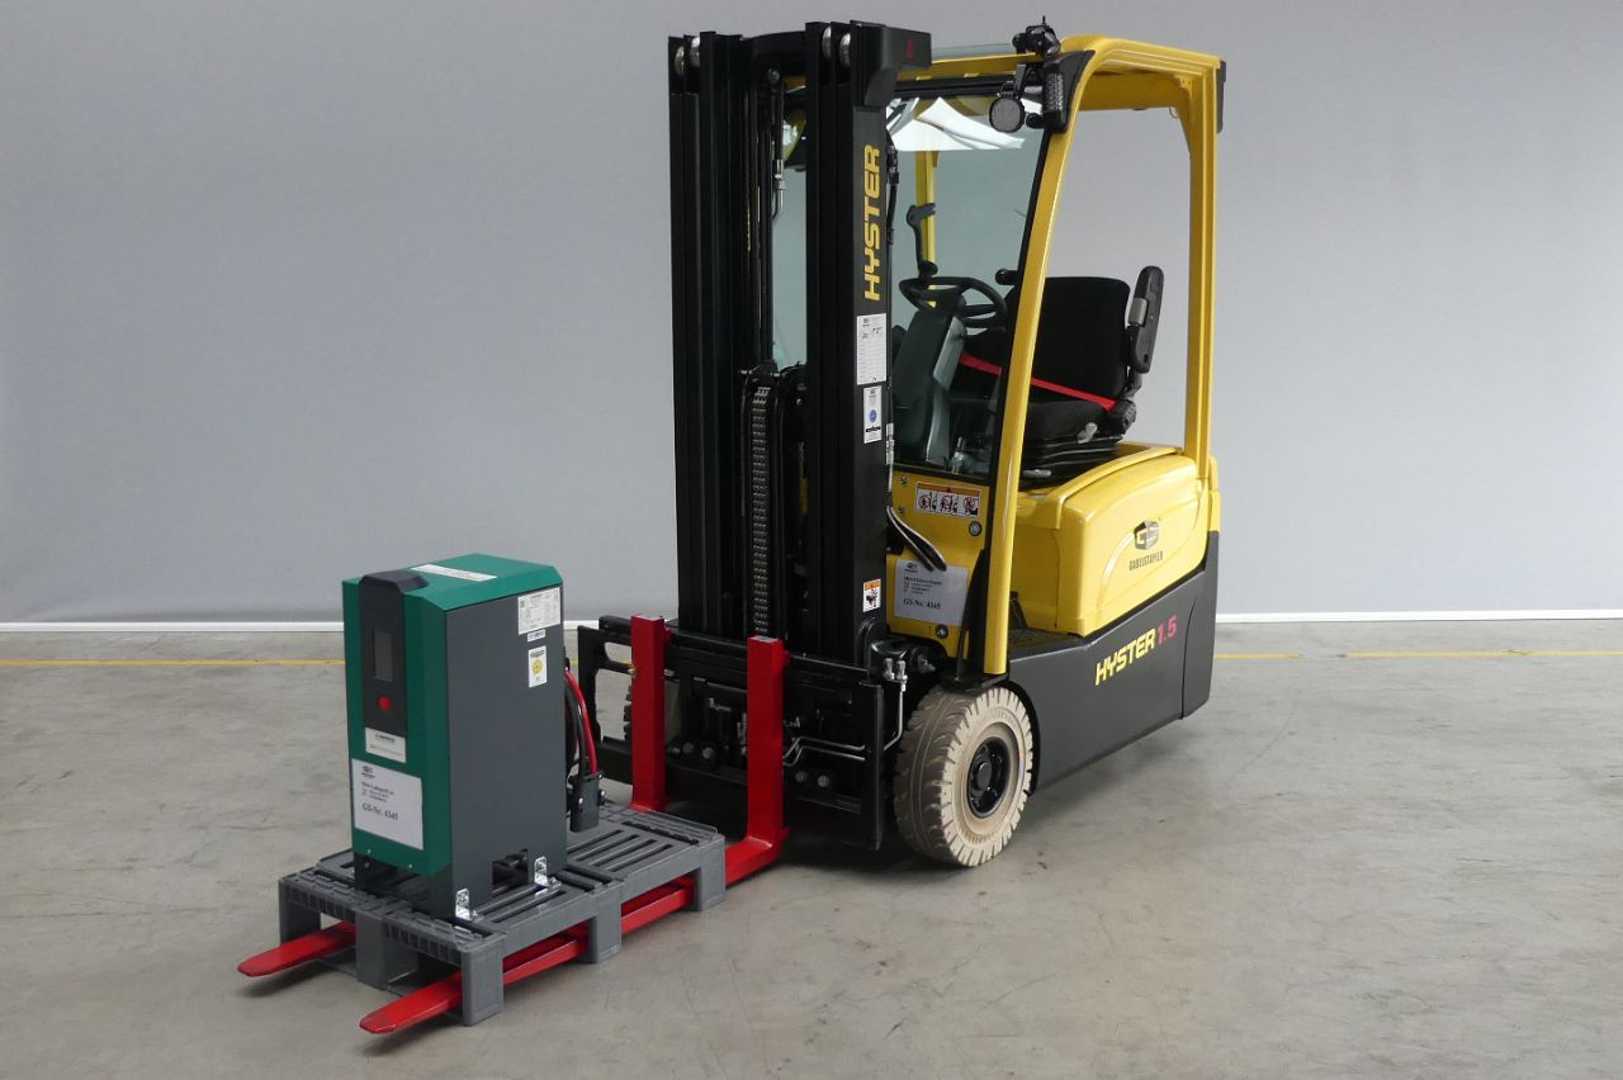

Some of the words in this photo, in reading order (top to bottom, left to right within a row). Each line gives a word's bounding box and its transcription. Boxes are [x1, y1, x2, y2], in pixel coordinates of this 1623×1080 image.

[864, 144, 881, 302] HYSTER
[1095, 628, 1156, 686] HYSTER
[1157, 614, 1178, 645] 1.5
